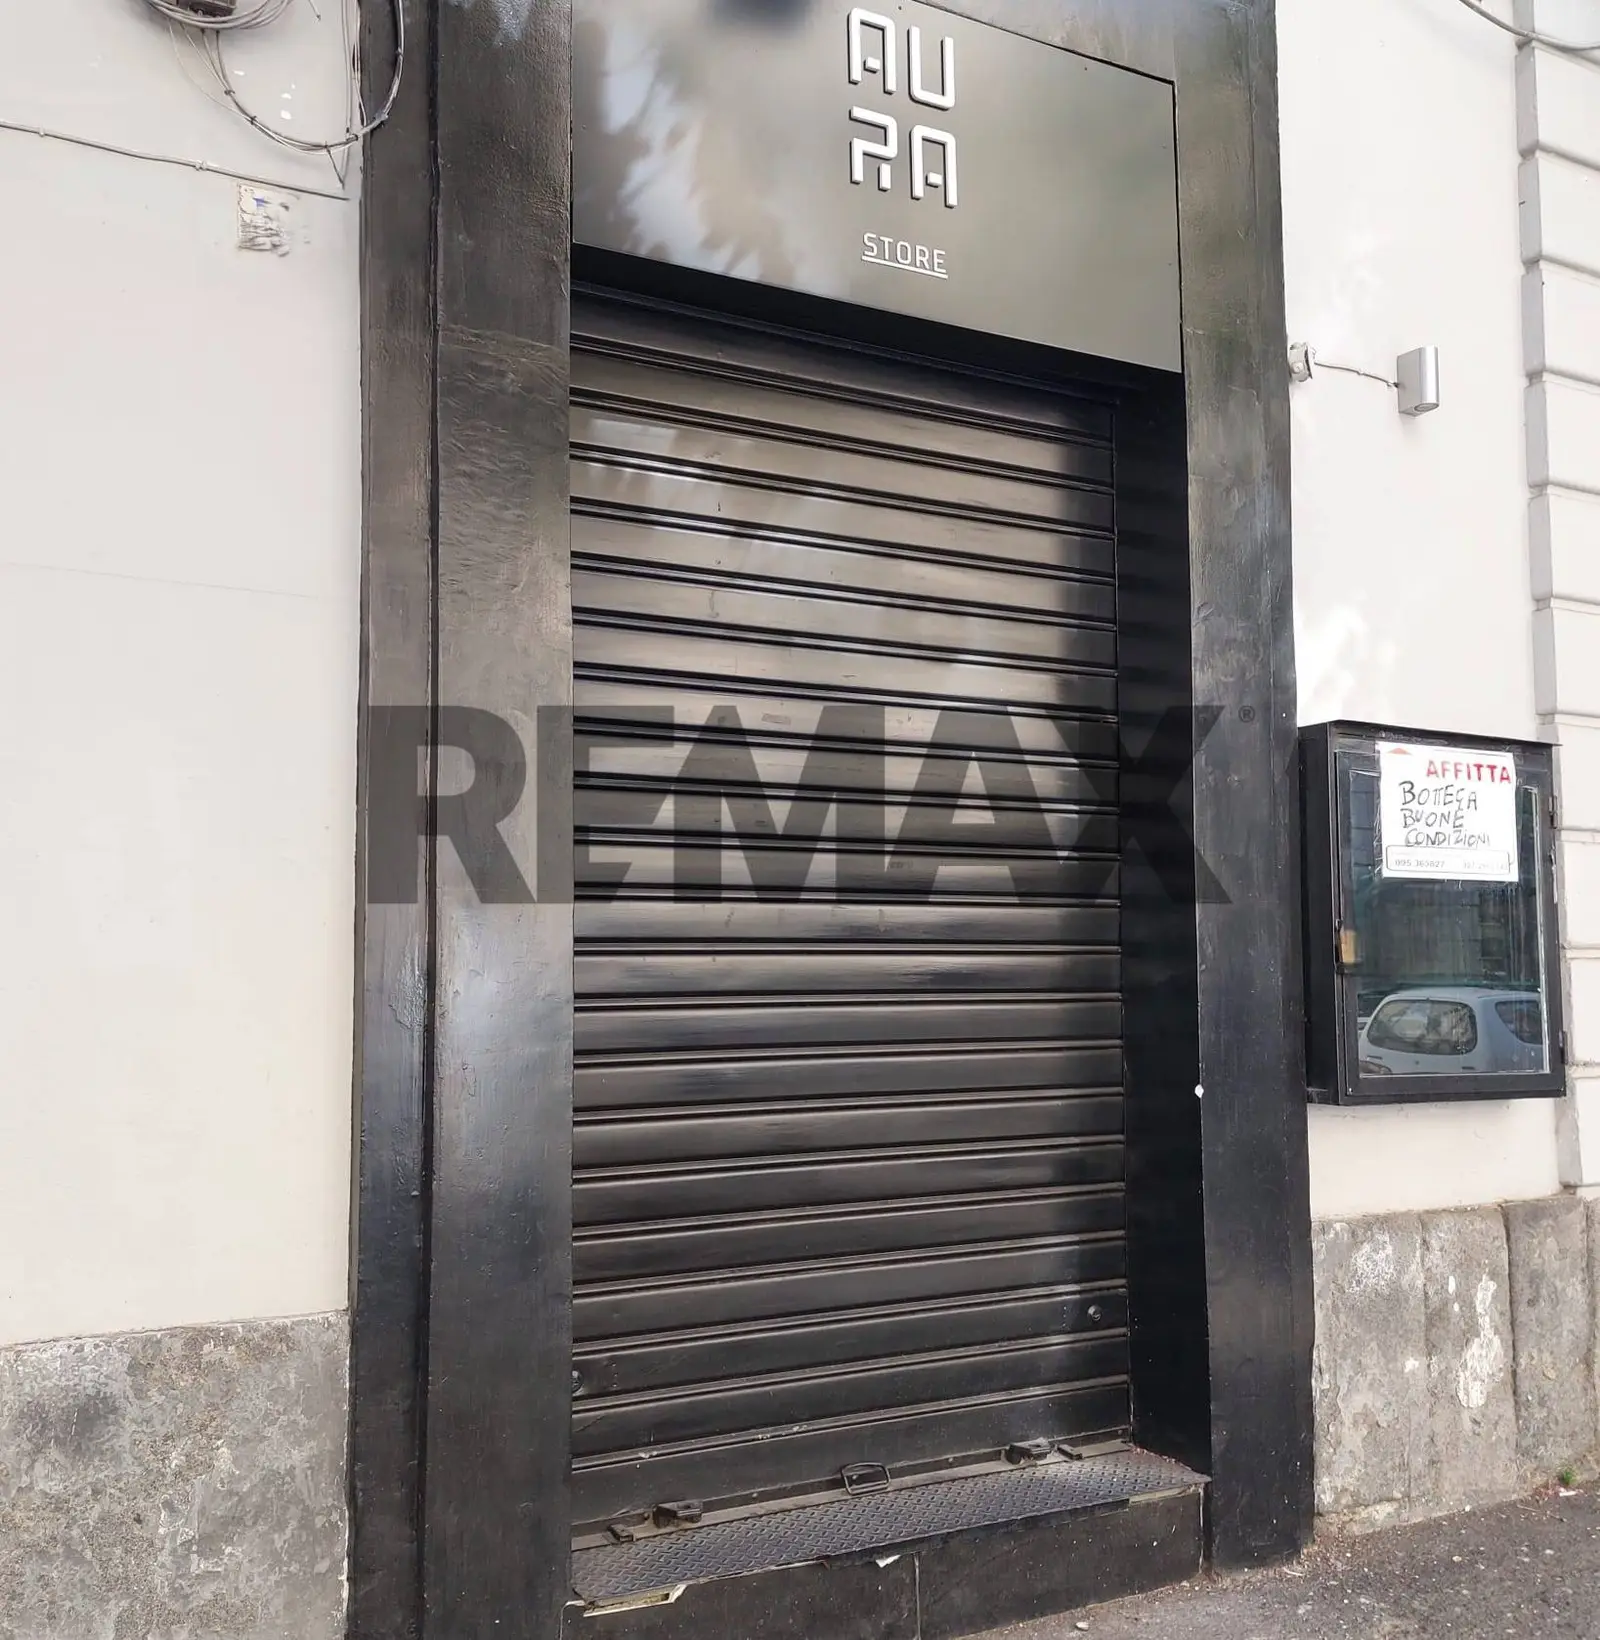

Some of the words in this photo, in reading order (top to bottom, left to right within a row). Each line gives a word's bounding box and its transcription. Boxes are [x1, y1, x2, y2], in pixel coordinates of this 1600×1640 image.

[848, 7, 956, 110] AU
[862, 232, 948, 275] STORE
[1426, 760, 1512, 784] AFFITTA
[1399, 780, 1478, 811] BOTTEGA
[1400, 808, 1465, 829] BUONE
